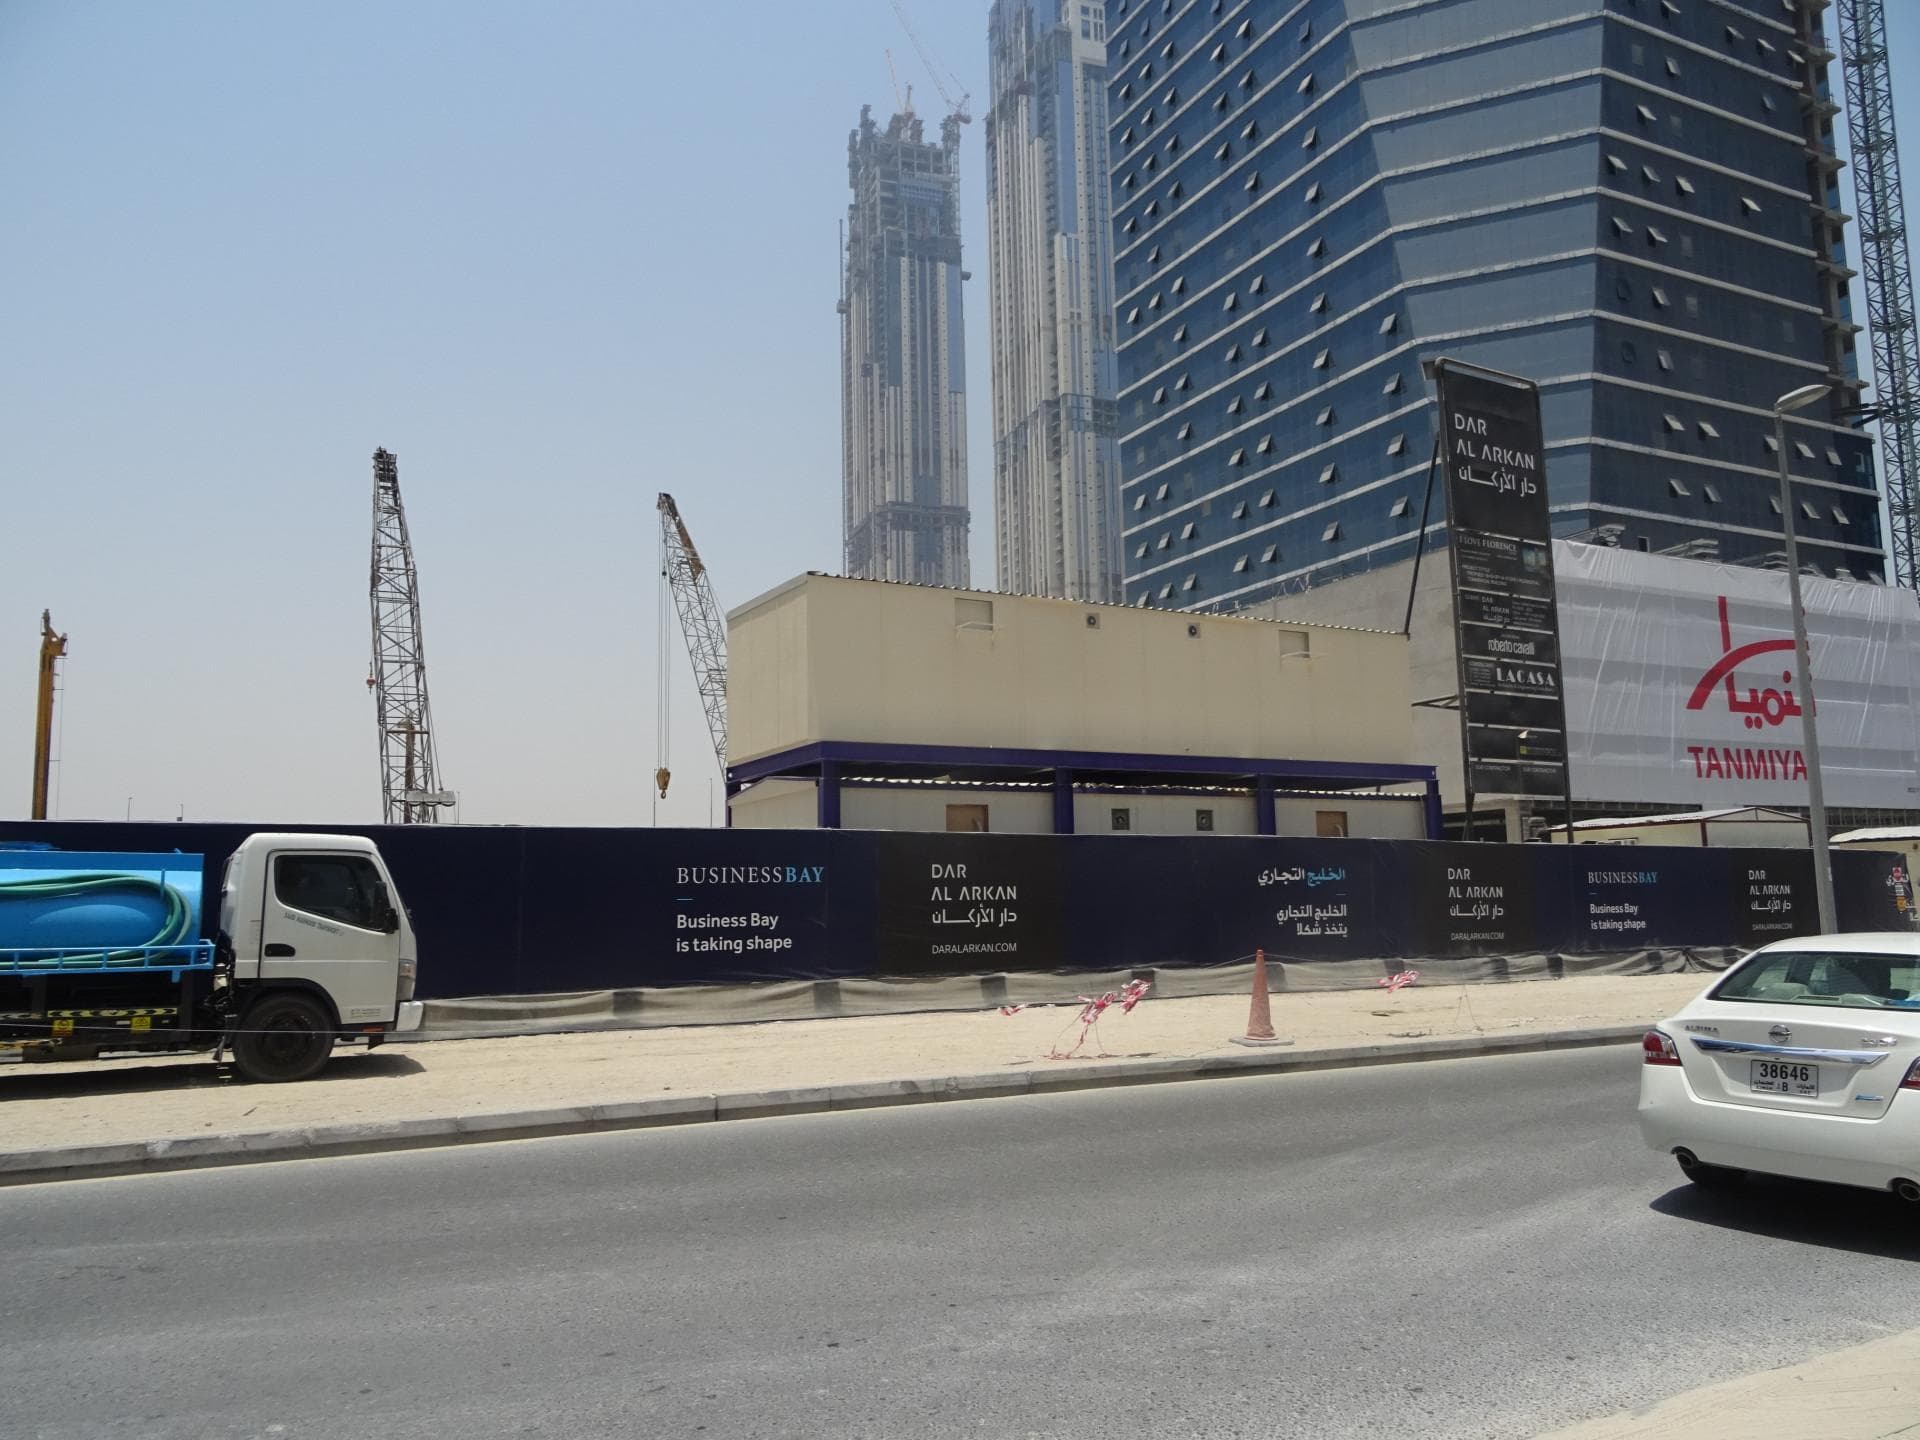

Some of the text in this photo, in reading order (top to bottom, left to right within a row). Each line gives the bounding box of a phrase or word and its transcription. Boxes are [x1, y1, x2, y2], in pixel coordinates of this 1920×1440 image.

[1454, 412, 1487, 436] DAR
[1456, 438, 1535, 470] AL ARKAN
[1520, 477, 1537, 497] دار
[1464, 536, 1481, 547] LOVE
[1482, 539, 1517, 552] FLORENCE
[1488, 639, 1535, 655] roberto cavalli
[1496, 667, 1555, 686] LACASA
[676, 865, 825, 884] BUSINESSBAY
[931, 864, 967, 879] DAR
[1257, 866, 1345, 887] الخليج التجاري
[1447, 868, 1471, 880] DAR
[1588, 871, 1658, 884] BUSINESSBAY
[1748, 870, 1766, 880] DAR
[931, 886, 1017, 901] AL ARKAN
[1448, 886, 1504, 898] AL ARKAN
[1749, 884, 1791, 895] AL ARKAN
[1276, 904, 1347, 925] الخليج التجاري
[1491, 905, 1504, 920] دار
[1590, 903, 1638, 915] Business Bay
[676, 912, 779, 930] Business Bay
[999, 909, 1018, 928] دار
[1590, 919, 1647, 931] is taking shape
[1323, 923, 1348, 938] يتخذ
[1450, 932, 1505, 941] DARALARKAN.COM
[676, 935, 793, 954] is taking shape
[931, 942, 1017, 955] DARALARKAN.COM
[1760, 1063, 1809, 1081] 38646
[1782, 1082, 1788, 1091] B
